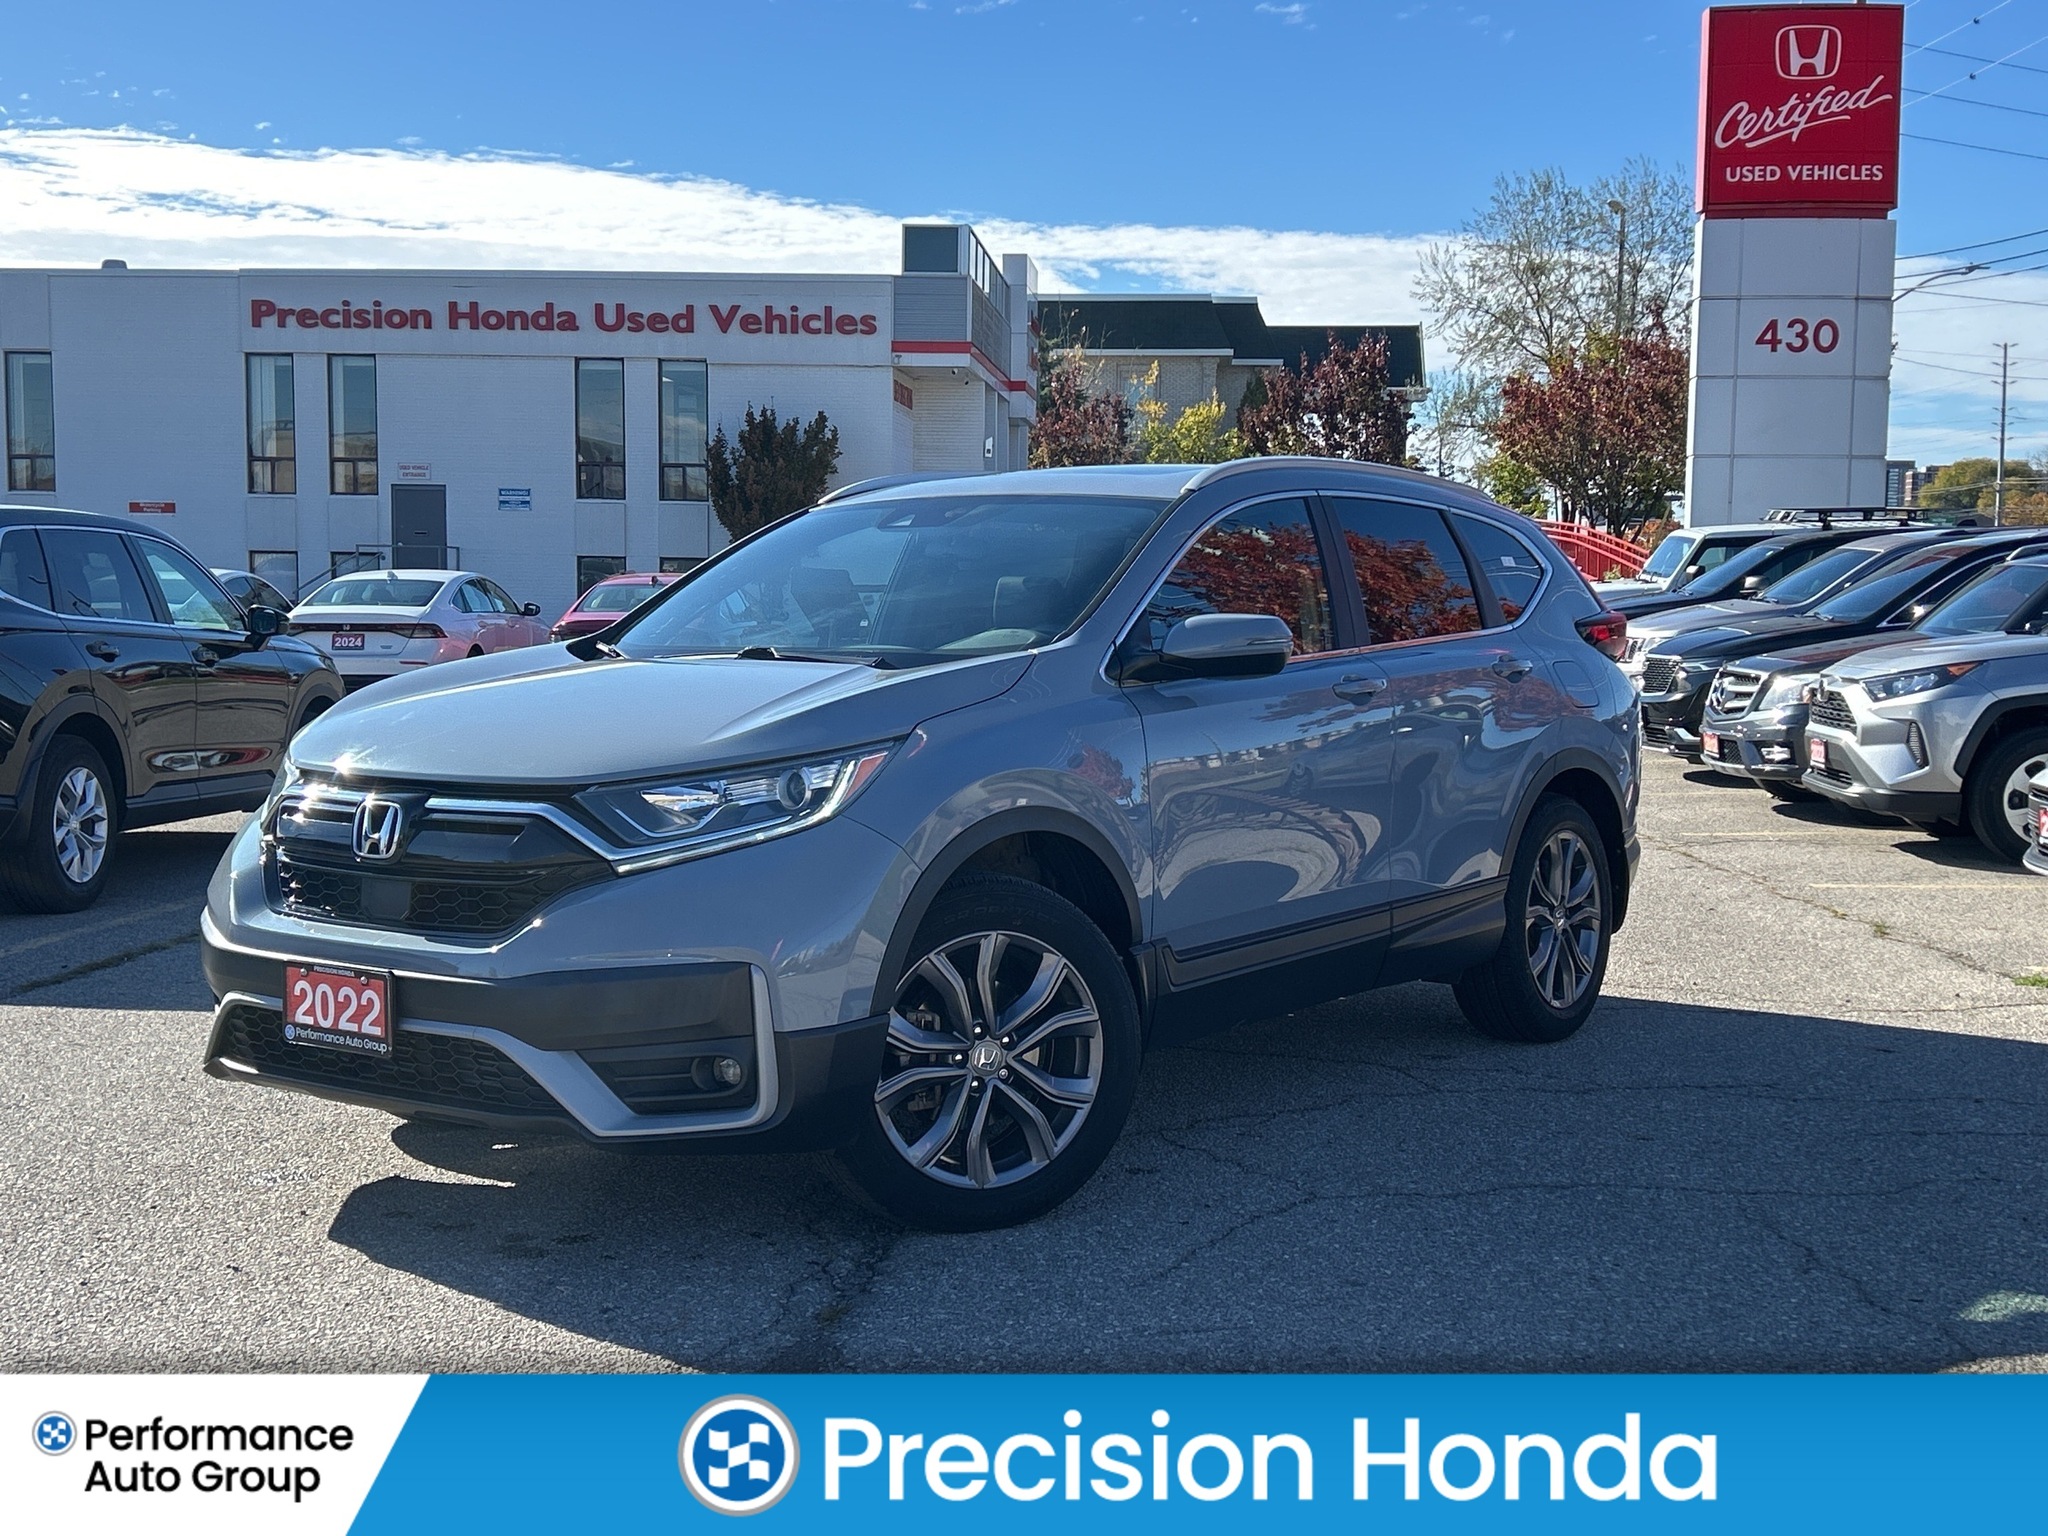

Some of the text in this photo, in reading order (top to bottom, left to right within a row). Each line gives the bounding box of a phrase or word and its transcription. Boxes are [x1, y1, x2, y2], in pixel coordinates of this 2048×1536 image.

[1714, 74, 1893, 149] Certified
[1725, 164, 1884, 183] USED VEHICLES
[250, 298, 878, 335] Precision Honda Used Vehicles
[1755, 318, 1840, 353] 430
[334, 637, 363, 647] 2024
[293, 979, 382, 1036] 2022
[295, 1026, 388, 1055] Performance Auto Group
